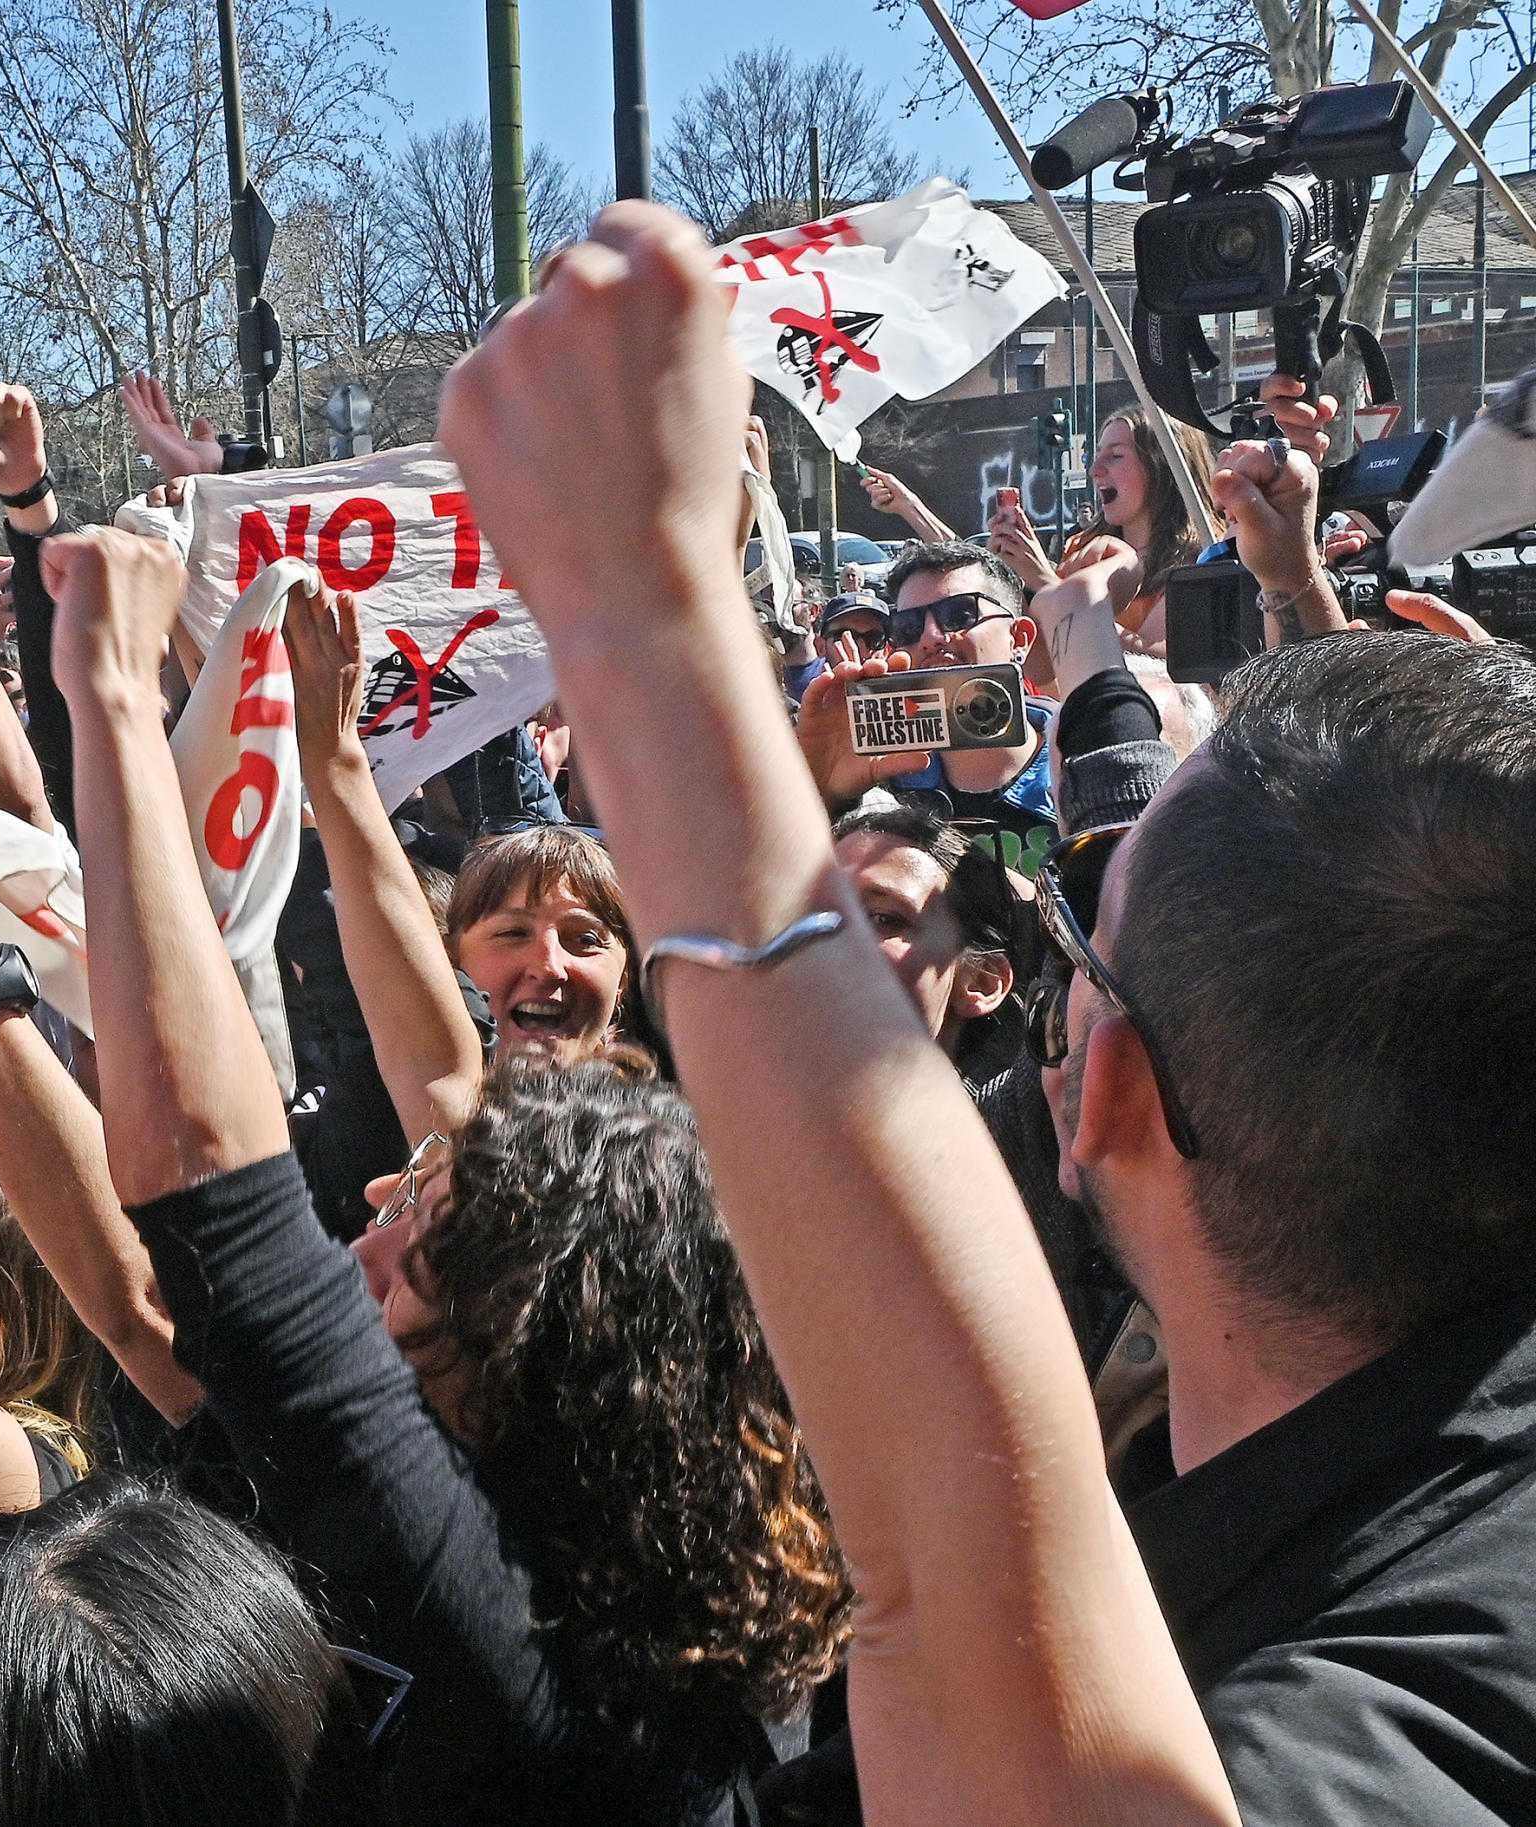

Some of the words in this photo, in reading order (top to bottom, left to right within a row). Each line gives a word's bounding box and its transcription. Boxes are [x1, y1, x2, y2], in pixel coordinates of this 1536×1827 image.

[236, 498, 396, 593] NO
[430, 492, 513, 590] T
[852, 697, 905, 723] FREE
[855, 718, 945, 747] PALESTINE
